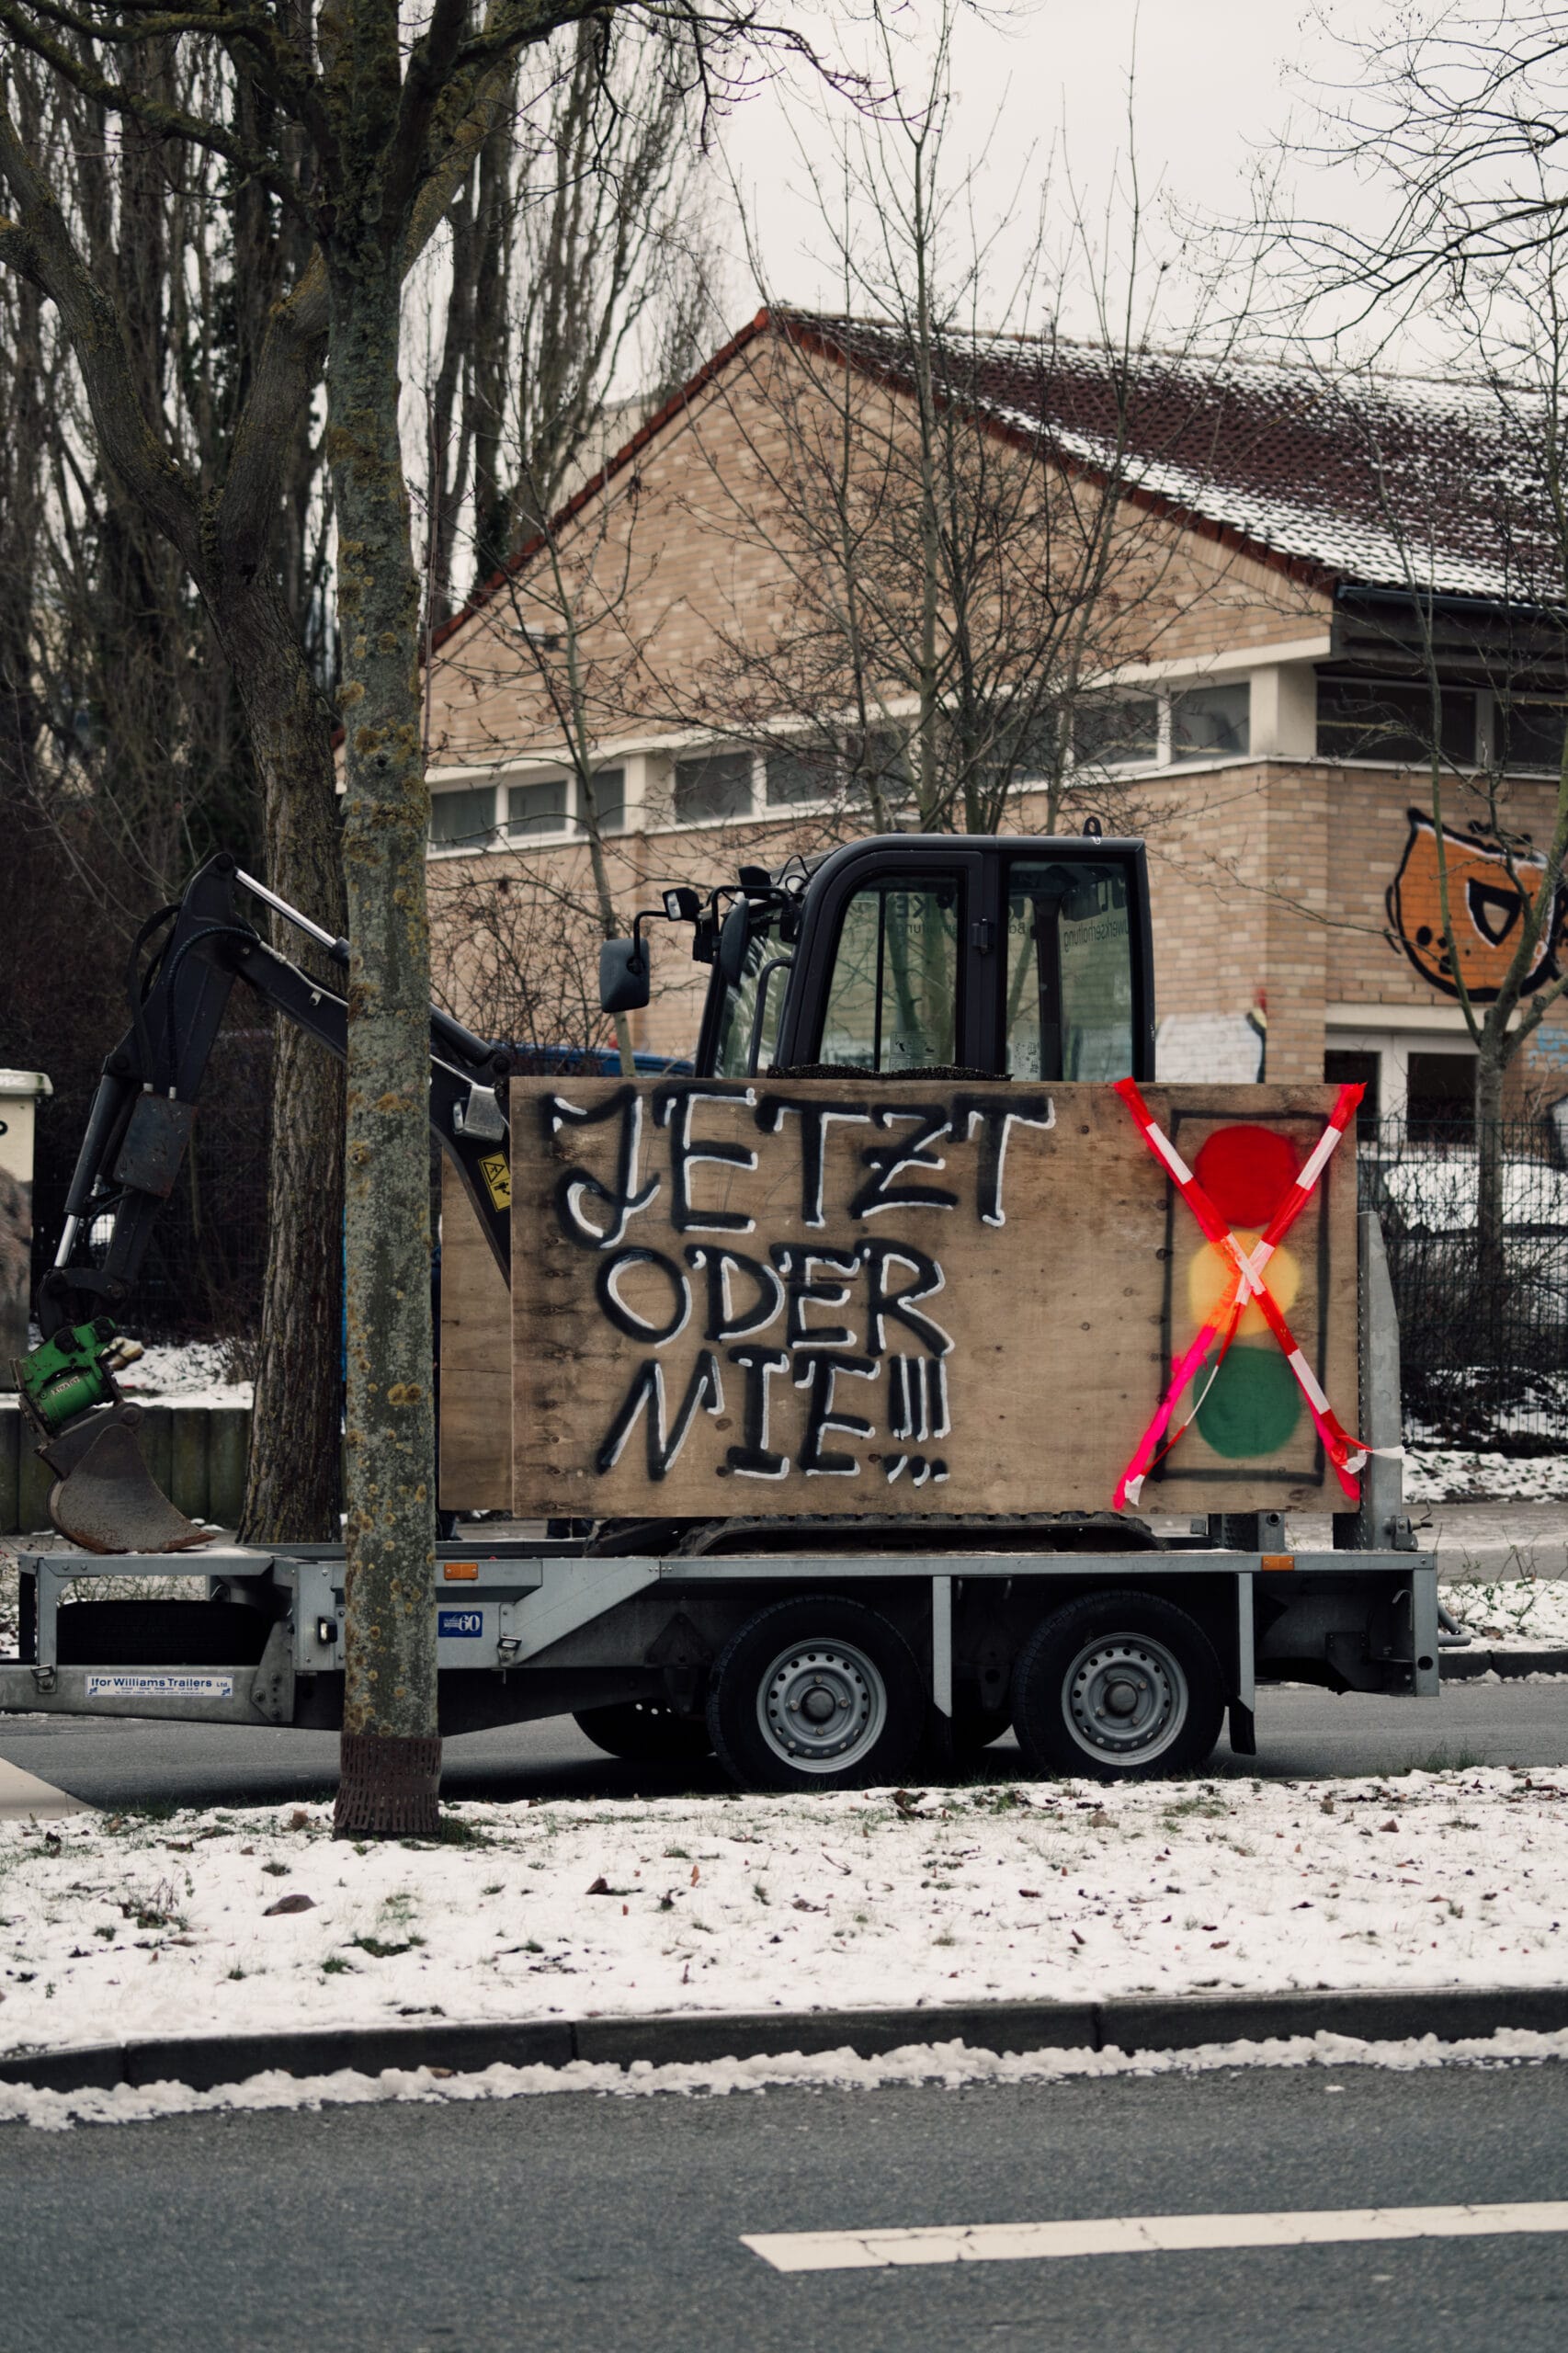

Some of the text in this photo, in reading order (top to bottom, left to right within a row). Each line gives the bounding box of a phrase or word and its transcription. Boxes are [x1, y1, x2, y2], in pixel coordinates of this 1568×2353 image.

[539, 1084, 1056, 1248] JETZT
[595, 1237, 955, 1357] ODER
[460, 1615, 480, 1631] 60
[91, 1677, 111, 1687] Ifor
[113, 1677, 165, 1687] Williams
[167, 1677, 212, 1687] Trailers
